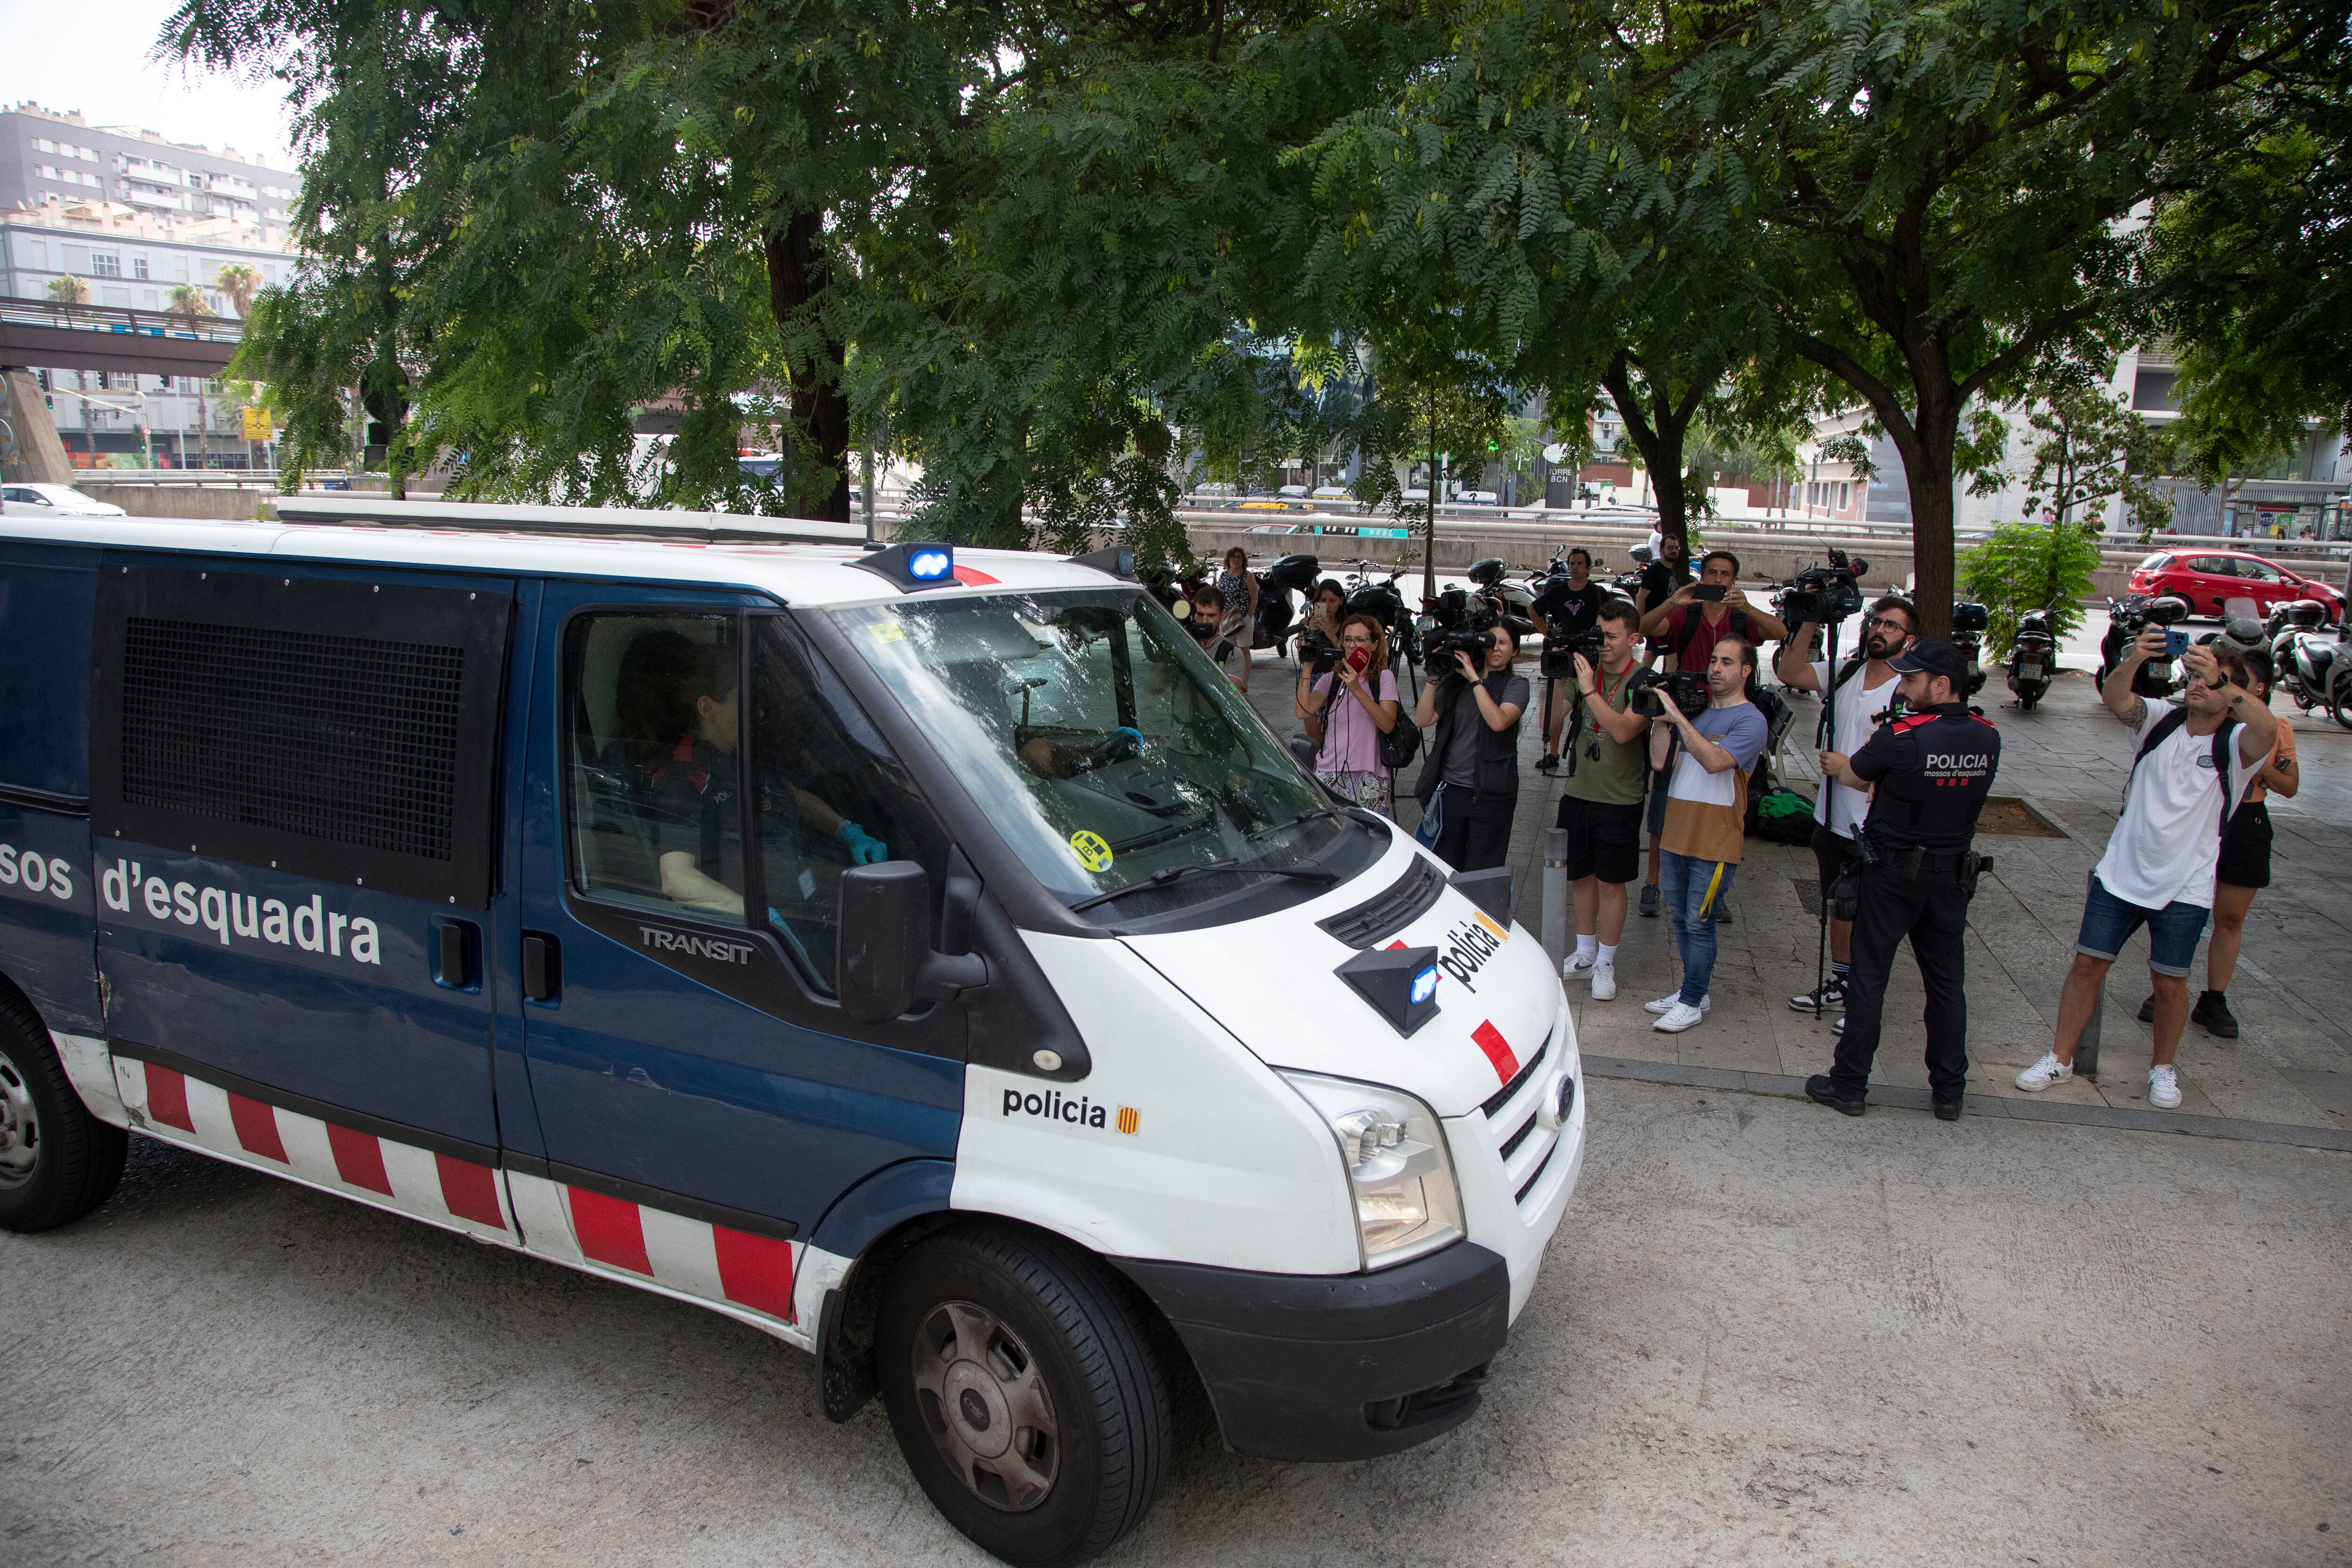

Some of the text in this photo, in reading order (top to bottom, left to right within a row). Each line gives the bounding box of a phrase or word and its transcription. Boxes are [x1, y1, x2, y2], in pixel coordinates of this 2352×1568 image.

[1926, 754, 1987, 769] POLICIA
[1952, 769, 1986, 778] d'esquadra
[1082, 846, 1093, 856] B
[102, 858, 381, 965] d'esquadra
[639, 926, 754, 964] TRANSIT
[1438, 921, 1500, 994] policia
[1003, 1089, 1106, 1129] policia
